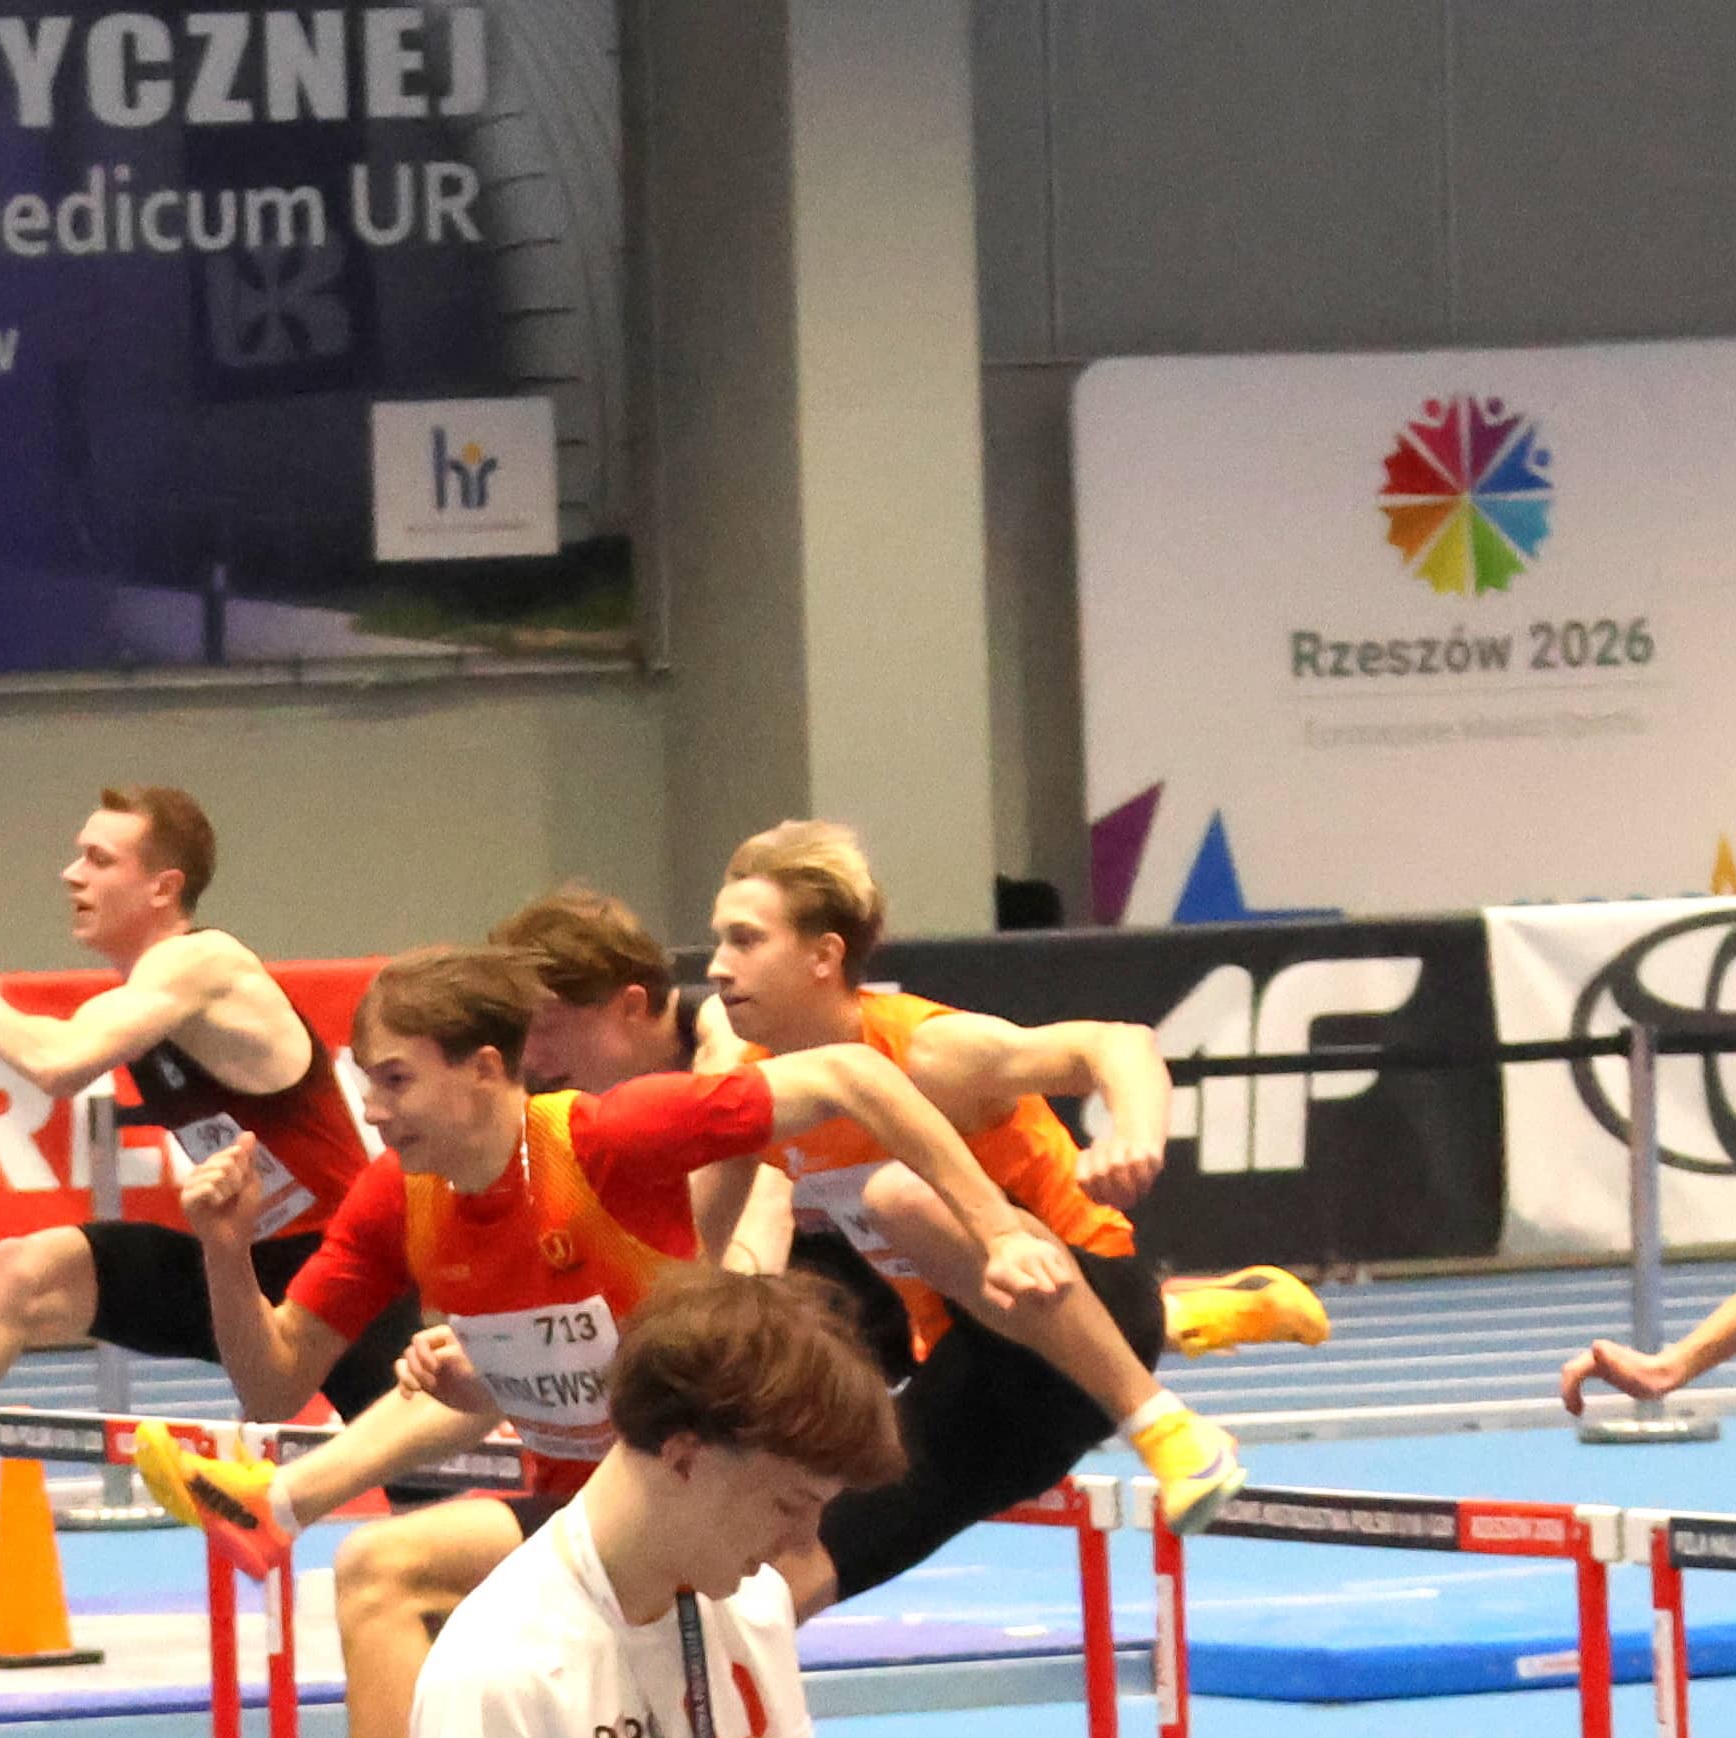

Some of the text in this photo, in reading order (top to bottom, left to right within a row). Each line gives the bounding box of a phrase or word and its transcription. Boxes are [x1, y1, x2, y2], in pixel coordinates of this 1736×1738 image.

[349, 162, 483, 247] UR
[1290, 618, 1655, 679] Rzeszów 2026
[534, 1313, 597, 1346] 713
